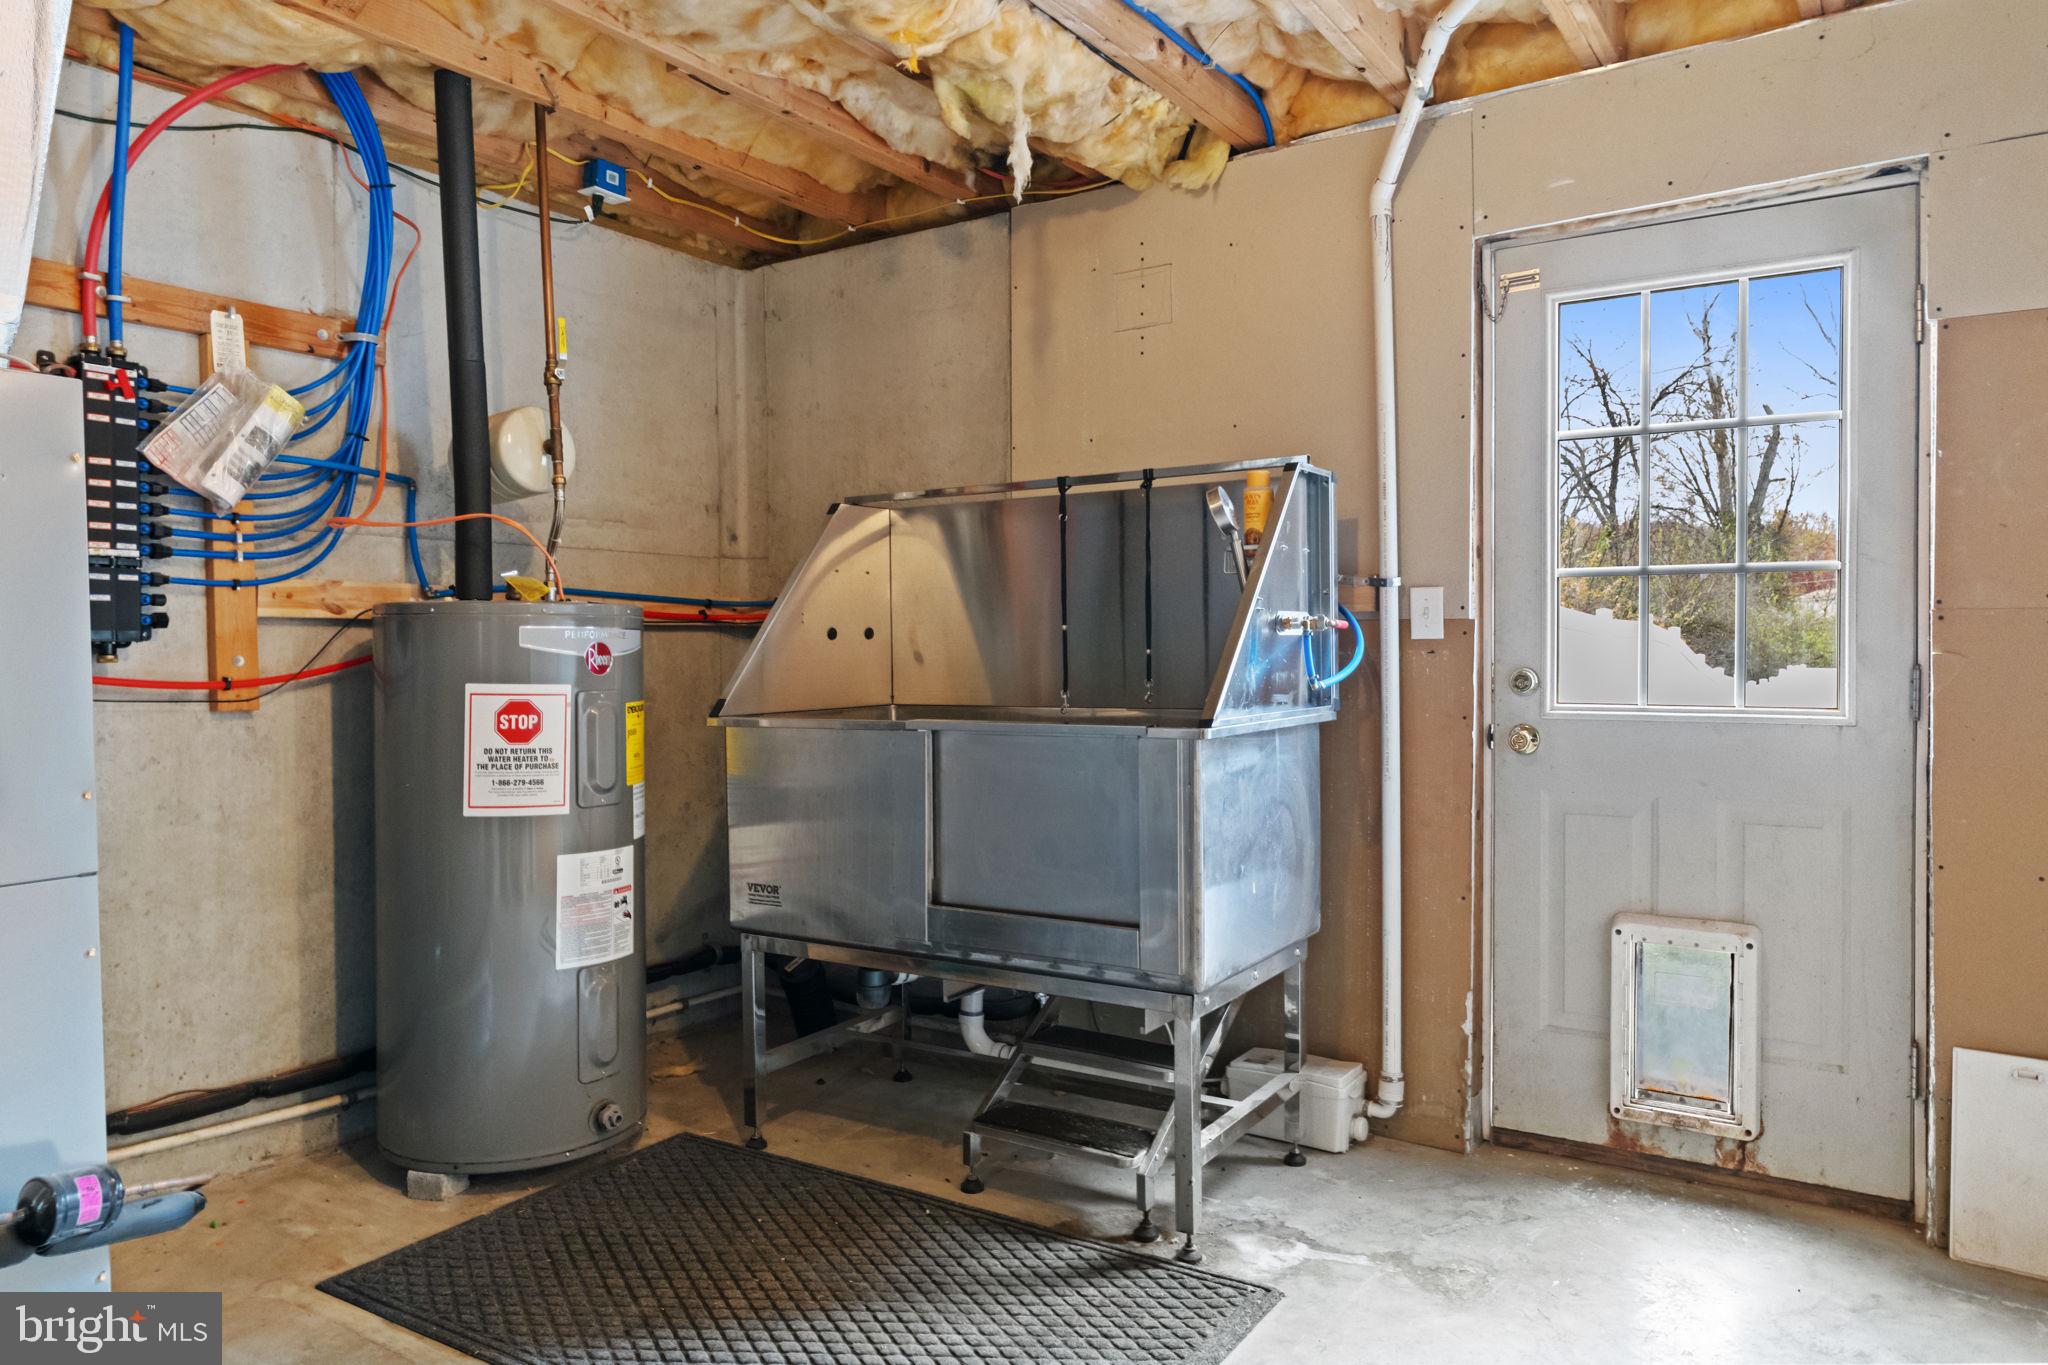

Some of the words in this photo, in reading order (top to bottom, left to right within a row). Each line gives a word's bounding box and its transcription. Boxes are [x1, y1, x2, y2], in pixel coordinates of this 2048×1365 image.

[499, 714, 539, 730] STOP
[495, 747, 508, 755] NOT
[510, 747, 537, 755] RETURN
[538, 747, 553, 755] THIS
[488, 755, 511, 763] WATER
[513, 755, 538, 763] HEATER
[476, 763, 489, 771] THE
[491, 763, 513, 771] PLACE
[525, 762, 559, 770] PURCHASE
[747, 883, 779, 895] VEVOR
